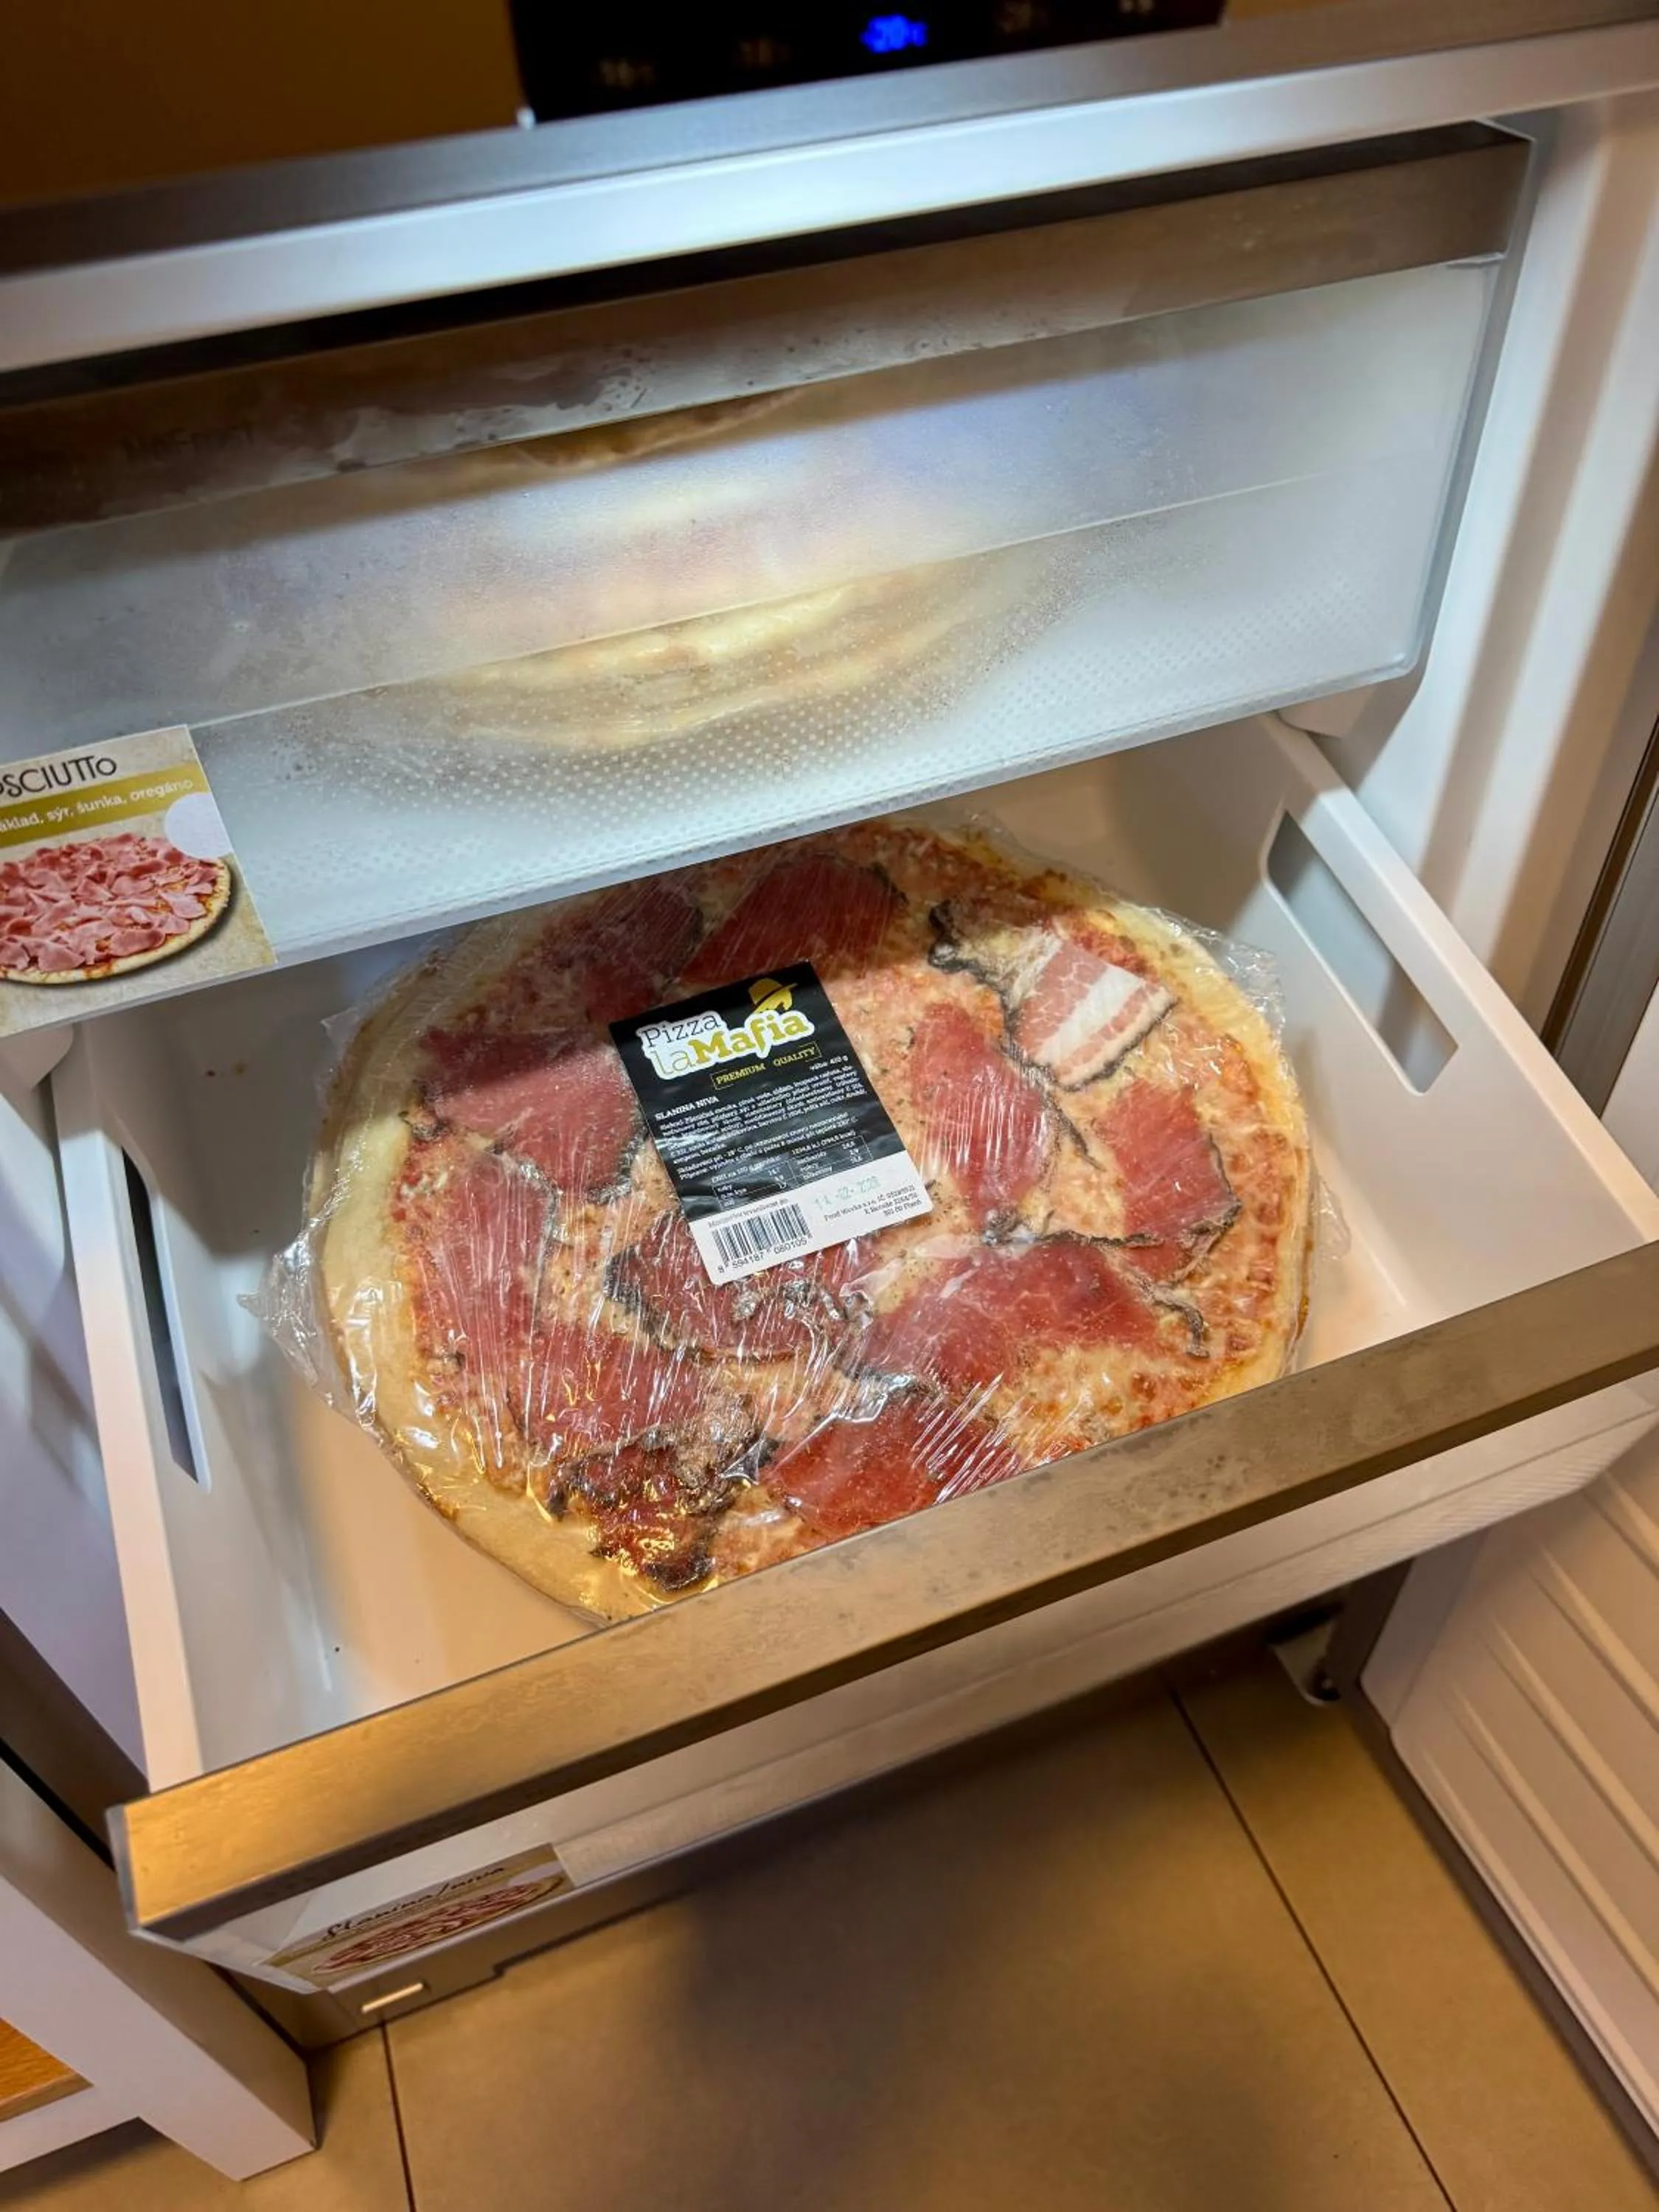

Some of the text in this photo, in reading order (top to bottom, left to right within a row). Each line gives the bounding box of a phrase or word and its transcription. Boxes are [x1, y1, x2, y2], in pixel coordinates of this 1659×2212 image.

[642, 1016, 721, 1048] Pizza
[714, 1046, 816, 1085] PREMIUM QUALITY
[654, 1094, 720, 1121] SLANINA NIVA
[717, 1265, 725, 1273] 8
[731, 1251, 764, 1270] 594187
